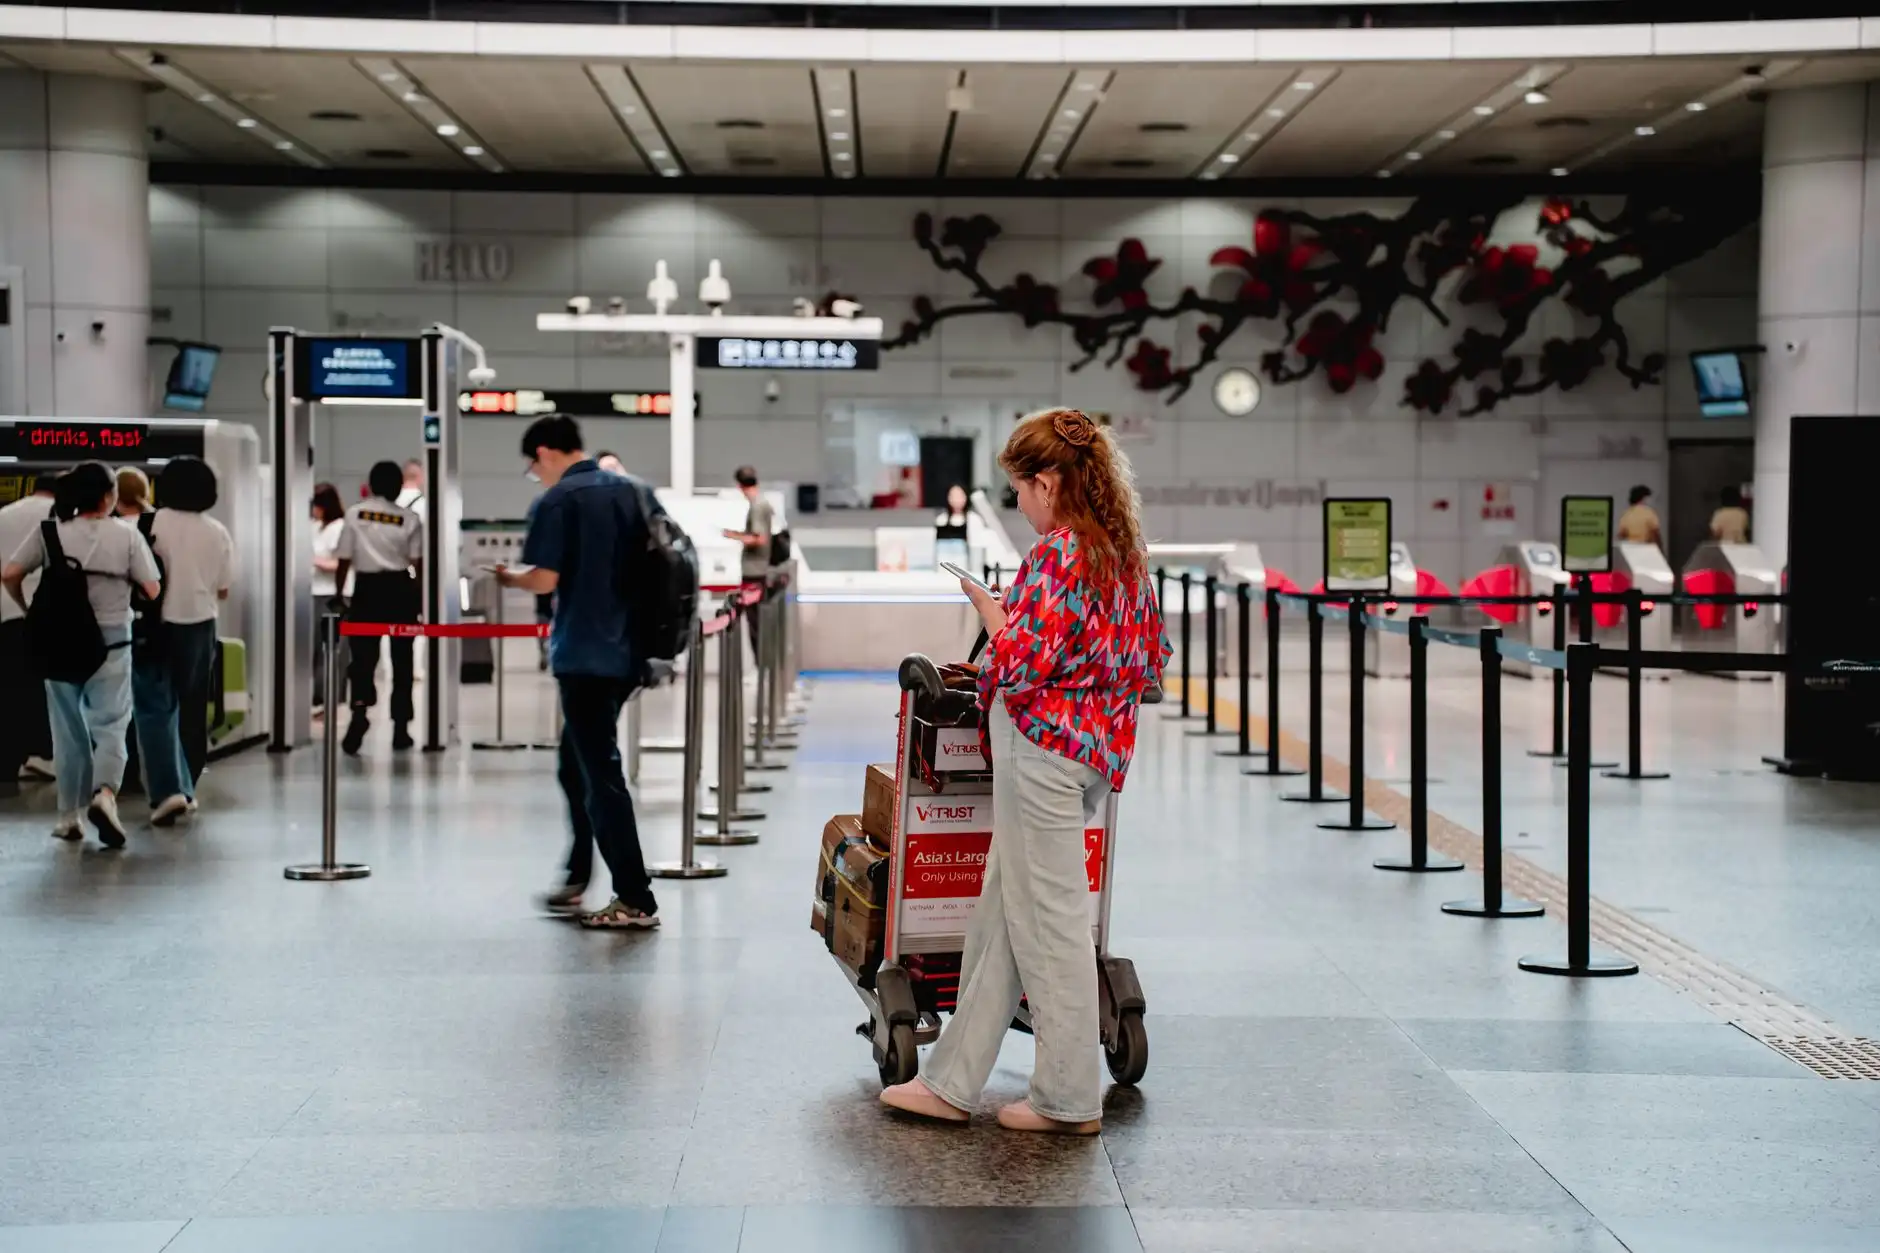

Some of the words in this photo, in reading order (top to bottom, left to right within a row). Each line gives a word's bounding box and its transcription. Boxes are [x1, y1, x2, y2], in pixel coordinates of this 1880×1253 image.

[414, 241, 515, 281] HELLO
[31, 428, 96, 449] drinks,
[914, 852, 952, 864] Asia's
[921, 871, 946, 884] Only
[949, 871, 978, 883] Using
